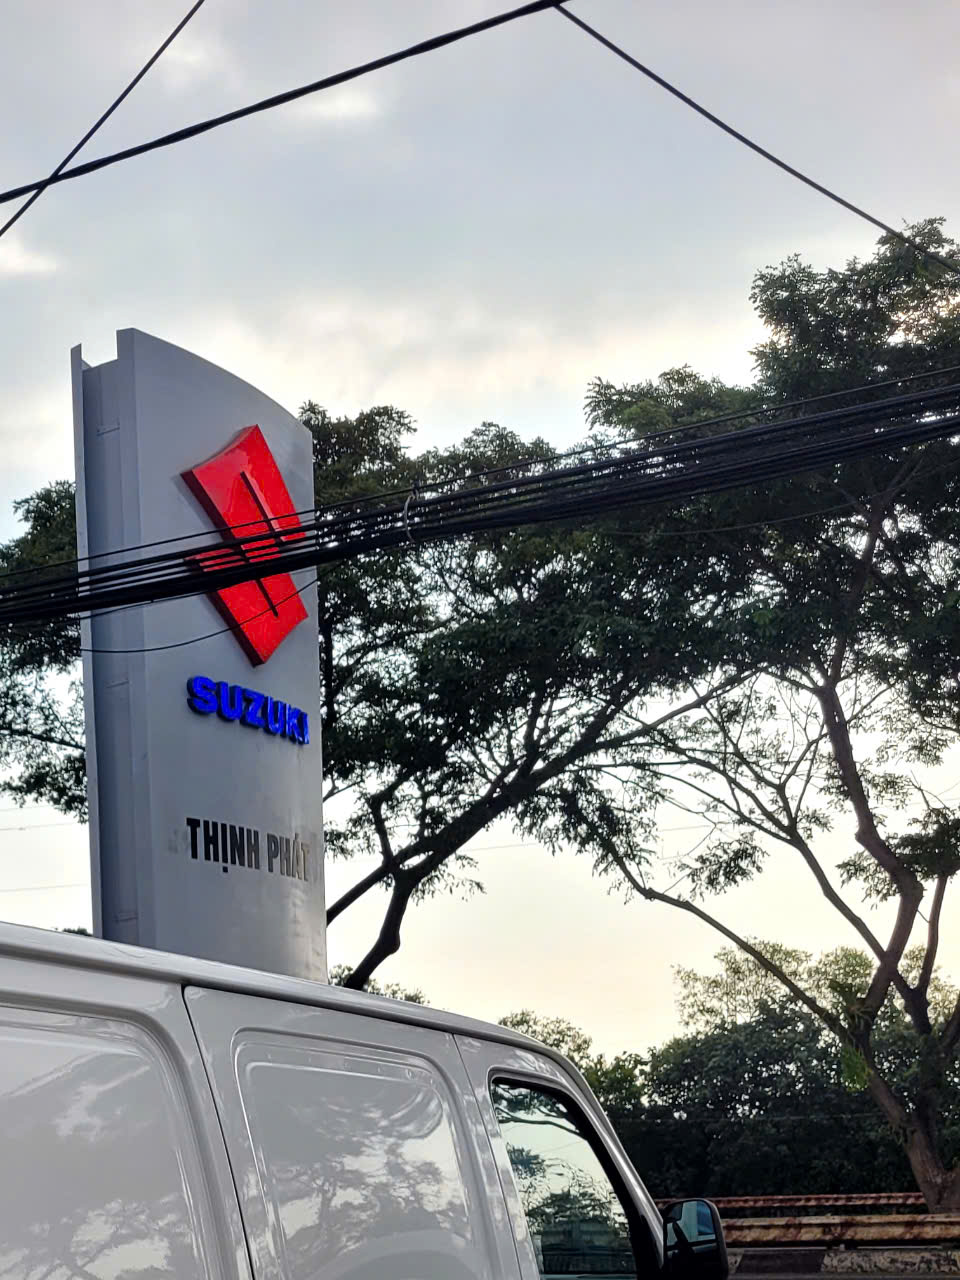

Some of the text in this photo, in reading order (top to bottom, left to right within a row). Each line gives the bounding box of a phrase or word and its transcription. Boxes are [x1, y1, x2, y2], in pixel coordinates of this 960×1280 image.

[187, 676, 310, 745] SUZUKI
[186, 817, 310, 882] THỊNH PHÁT
